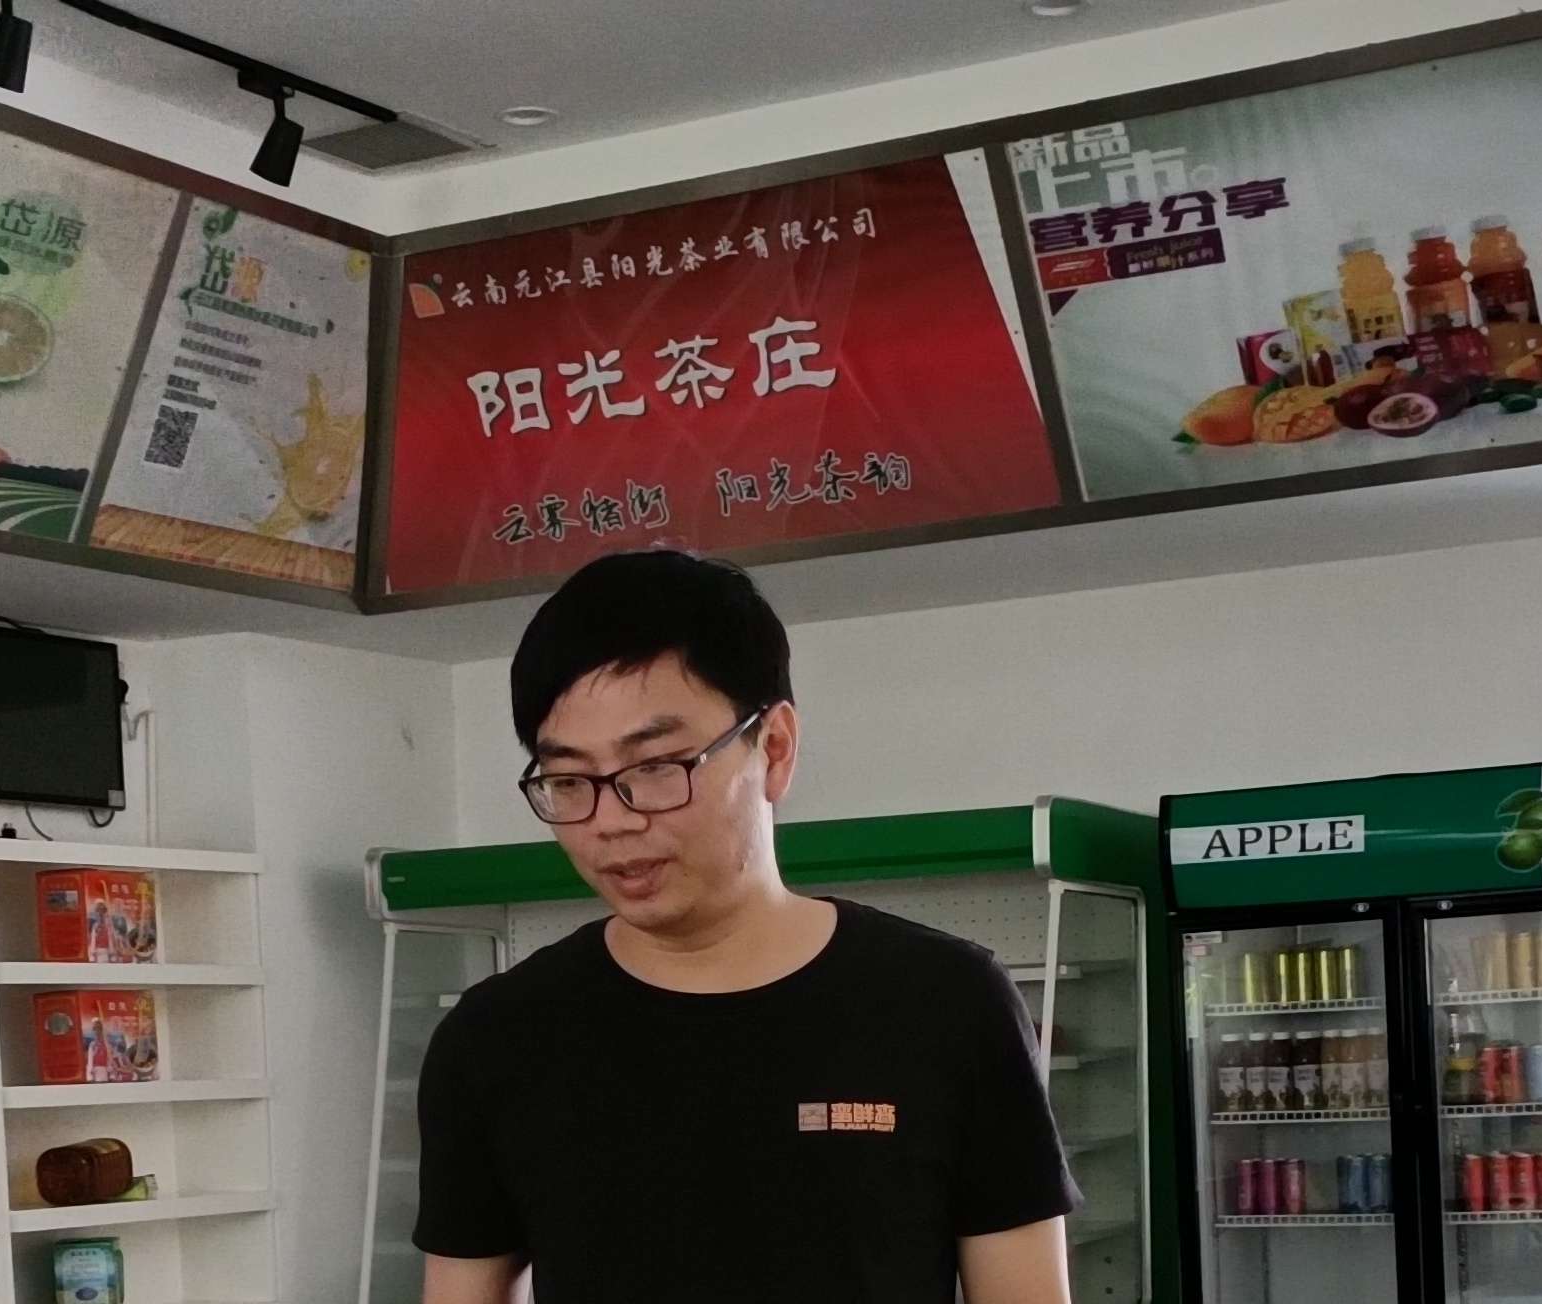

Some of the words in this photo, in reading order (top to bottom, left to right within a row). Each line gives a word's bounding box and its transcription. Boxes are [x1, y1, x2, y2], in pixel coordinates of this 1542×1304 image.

[1008, 121, 1131, 172] 新品
[1029, 177, 1290, 253] 营养分享
[450, 207, 880, 309] 云南元江县阳光茶业有限公司
[467, 315, 840, 439] 阳光茶庄
[1203, 819, 1355, 861] APPLE
